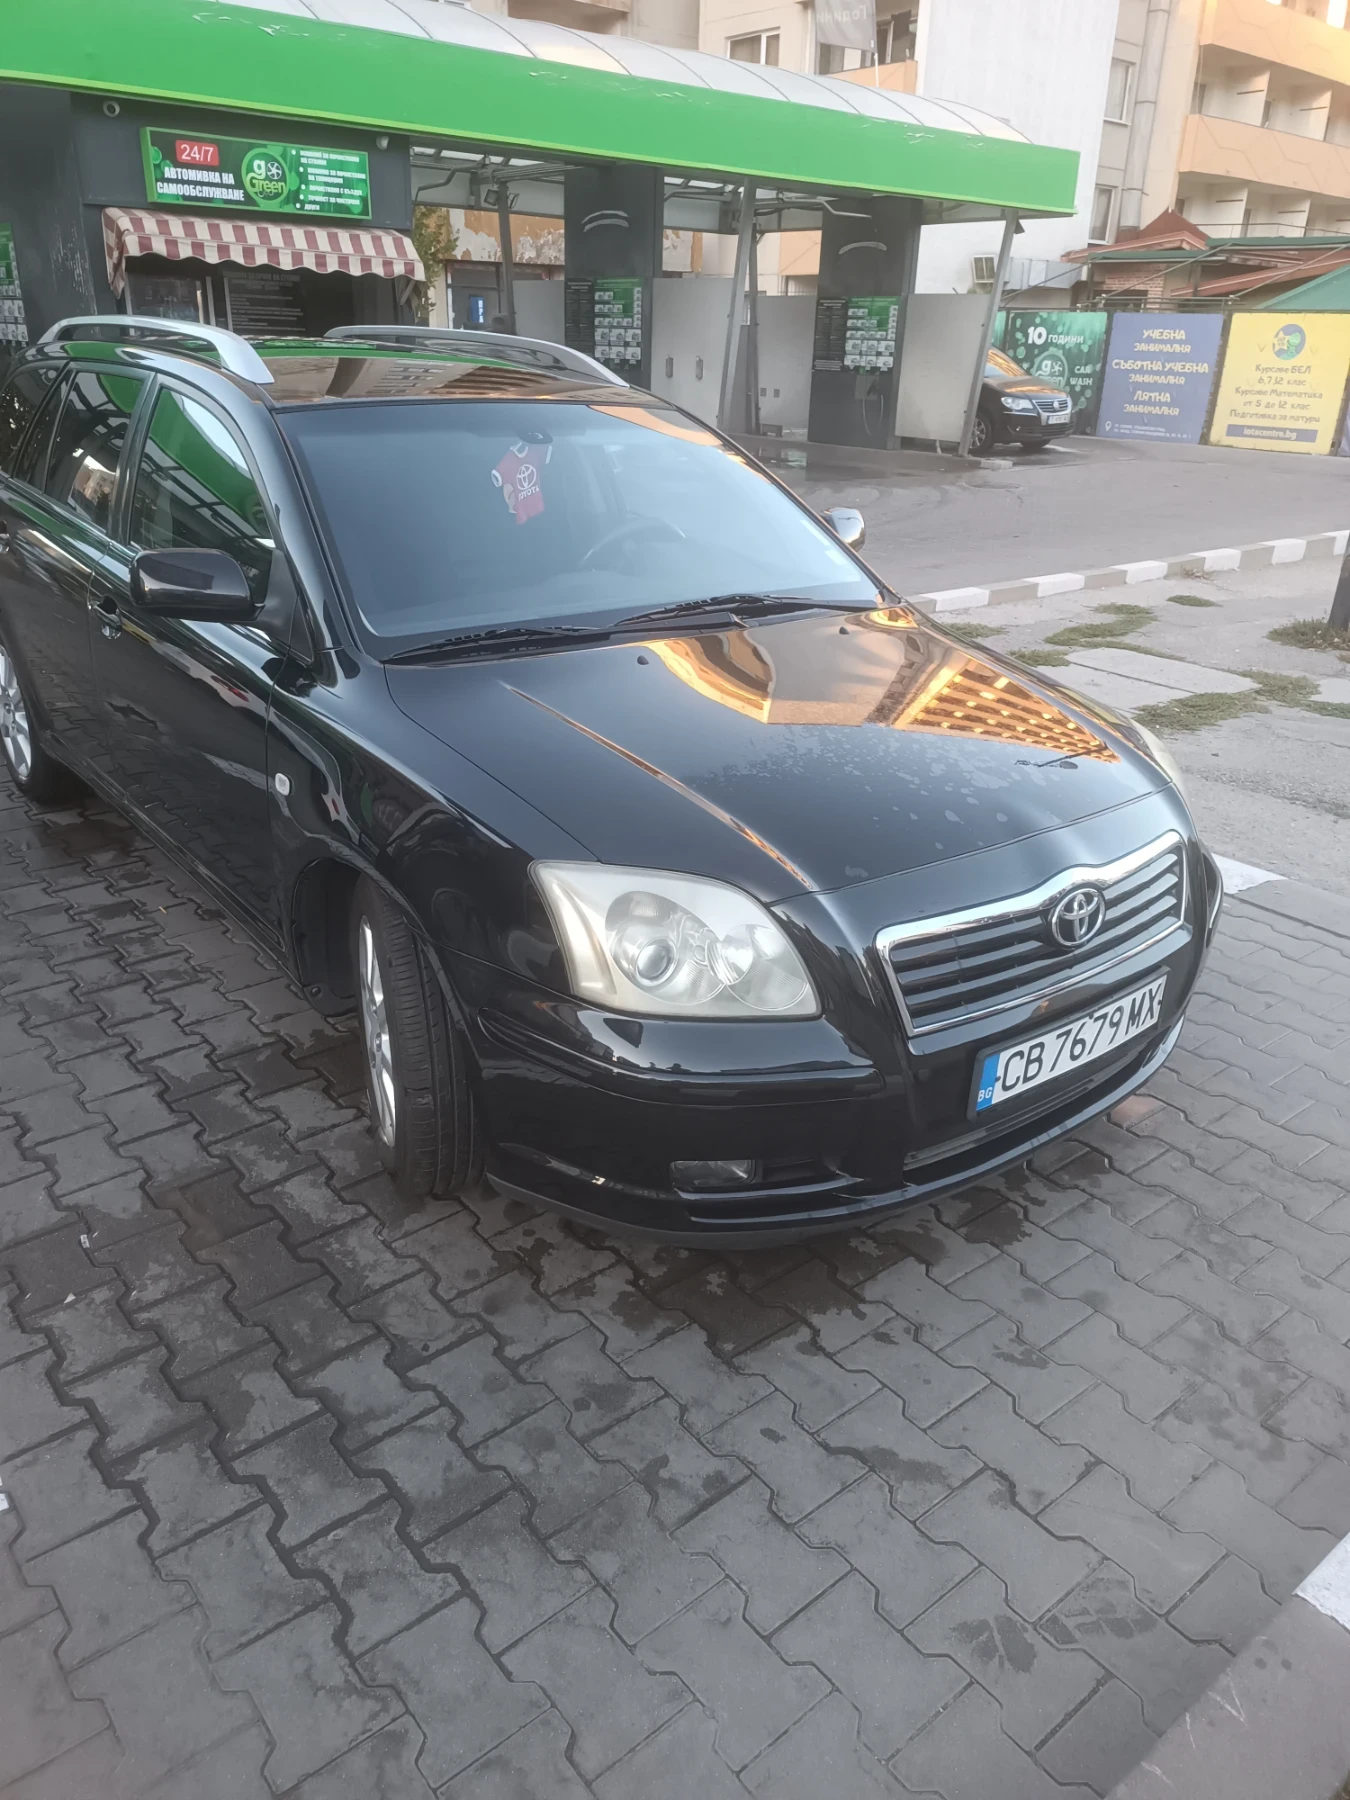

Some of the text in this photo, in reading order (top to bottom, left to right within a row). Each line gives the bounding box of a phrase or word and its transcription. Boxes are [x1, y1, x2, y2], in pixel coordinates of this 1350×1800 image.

[181, 144, 214, 162] 24/7
[164, 167, 235, 185] АВТОМИВКА НА
[247, 173, 286, 195] Green
[157, 182, 244, 201] САМООБСЛУЖВАНЕ
[1027, 326, 1047, 345] 10
[1142, 329, 1186, 340] УЧЕБНА
[1134, 342, 1191, 353] ЗАНИМАЛНЯ
[1112, 359, 1209, 373] СЪБОТНА УЧЕБНА
[1290, 365, 1312, 374] БЕЛ
[1070, 378, 1093, 386] WASH
[1128, 374, 1186, 385] ЗАНИМАЛНЯ
[1134, 390, 1171, 402] ЛЯТНА
[1123, 404, 1180, 416] ЗАНИМАЛНЯ
[978, 1087, 992, 1102] BG
[1049, 1005, 1124, 1072] 7679
